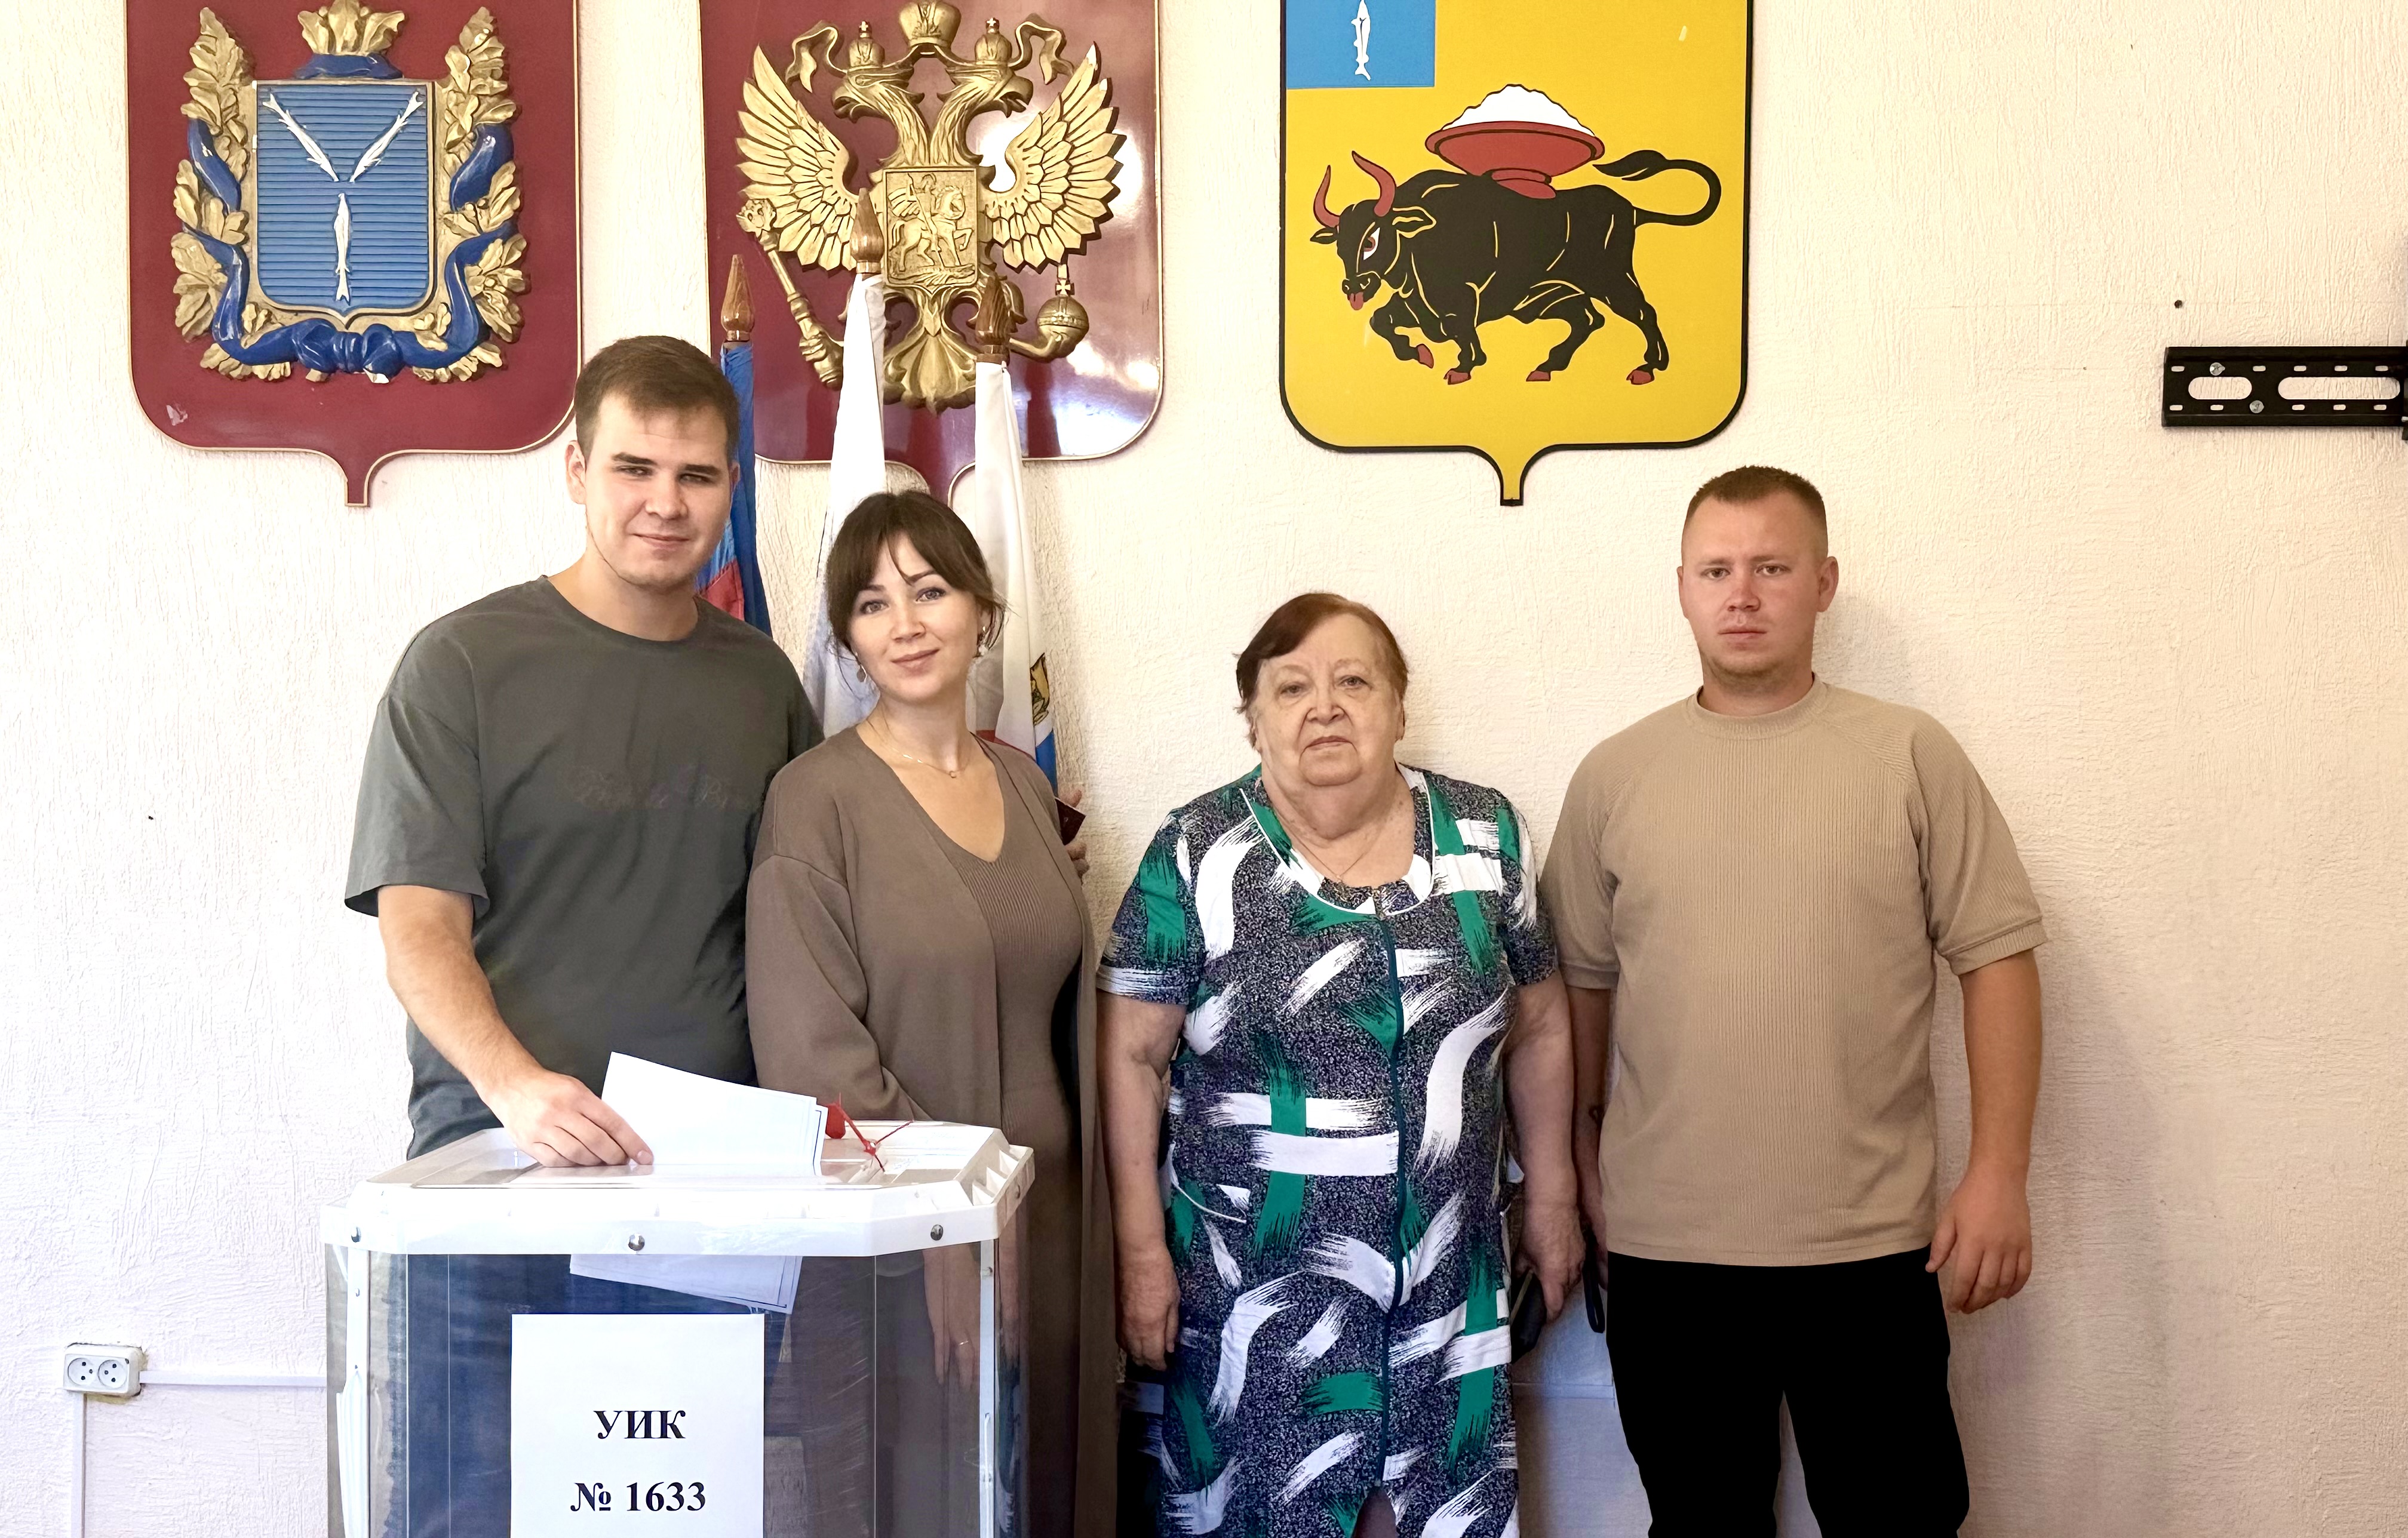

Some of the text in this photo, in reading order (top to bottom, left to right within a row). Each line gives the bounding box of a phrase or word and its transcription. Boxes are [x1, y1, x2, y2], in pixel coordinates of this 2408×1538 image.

[593, 1410, 686, 1439] УИК
[570, 1481, 706, 1512] № 1633
